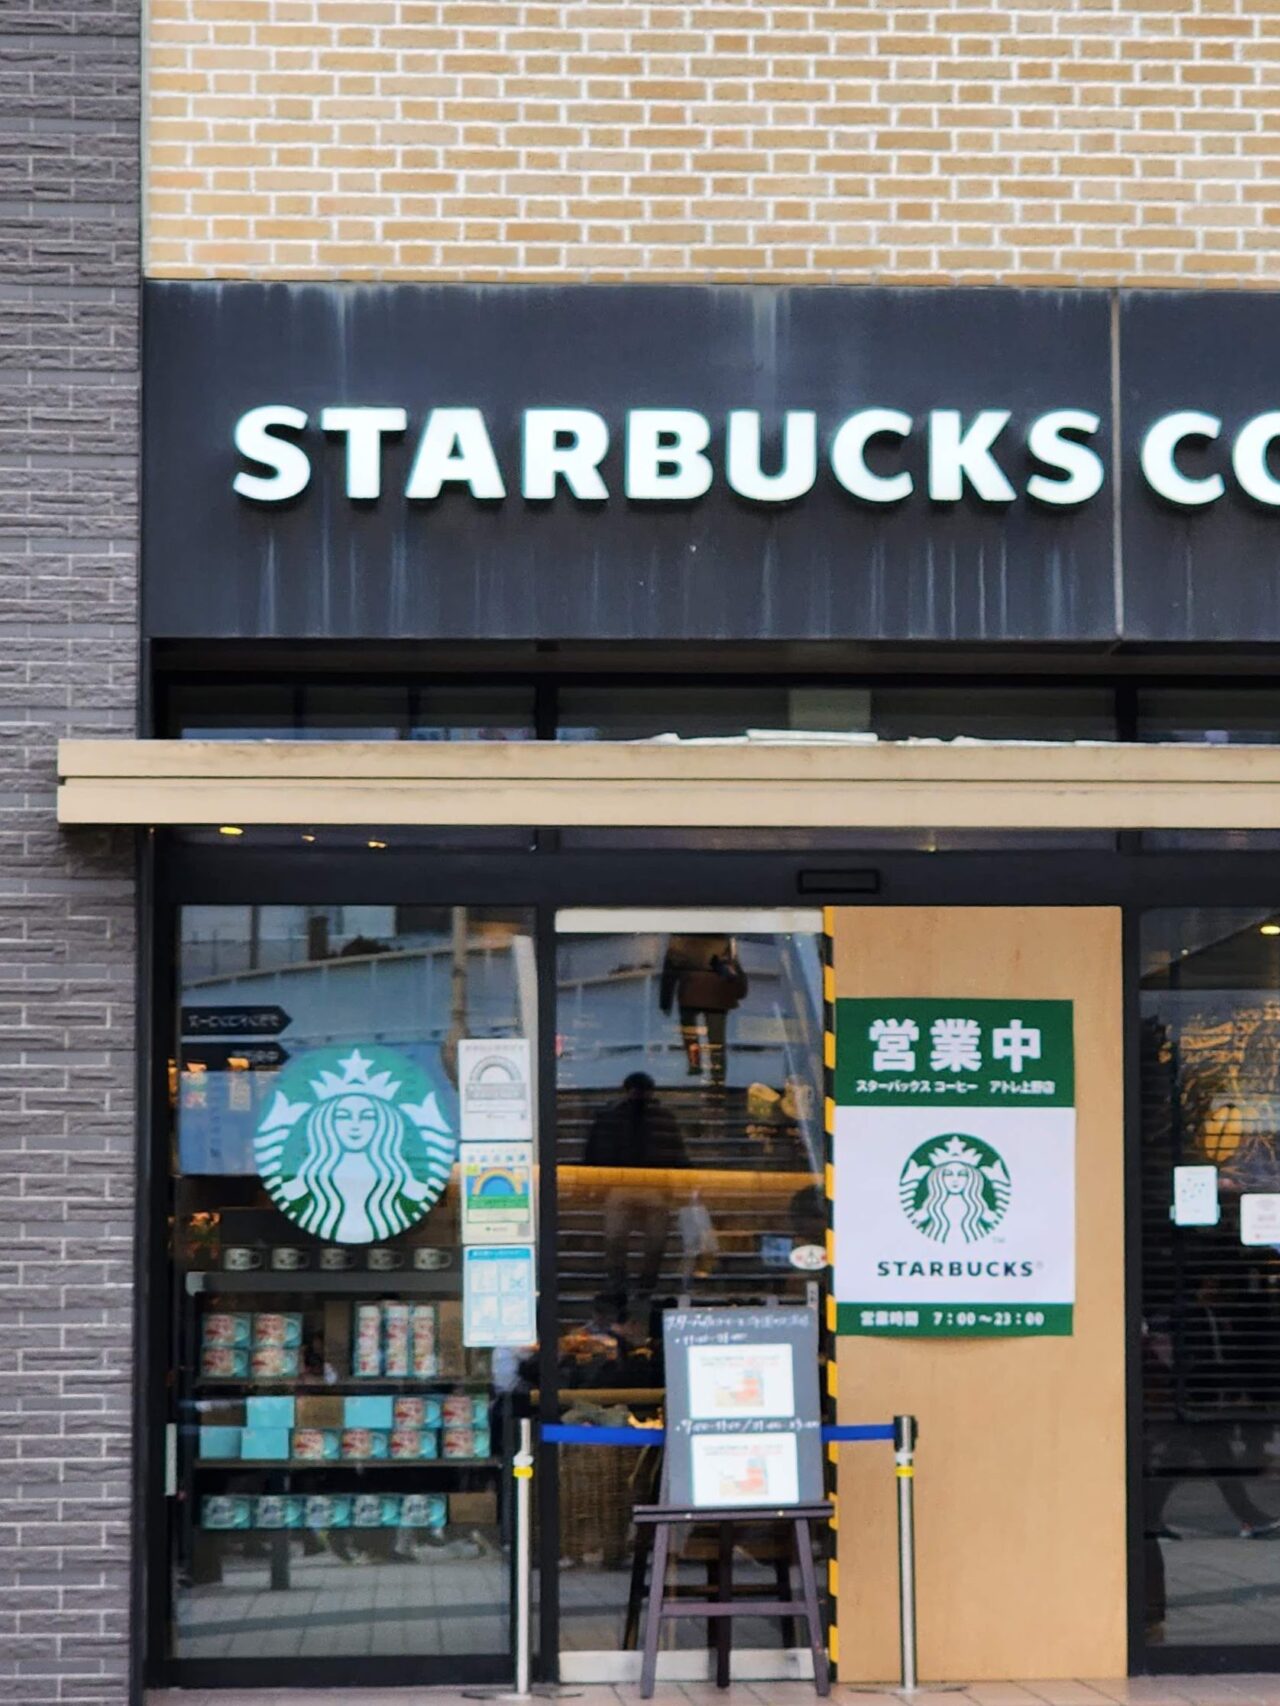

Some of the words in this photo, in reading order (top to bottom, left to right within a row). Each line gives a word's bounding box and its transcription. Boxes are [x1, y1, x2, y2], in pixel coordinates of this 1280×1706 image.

[232, 405, 1104, 505] STARBUCKS
[868, 1018, 1042, 1073] 営業中
[856, 1079, 932, 1093] スターバックス
[934, 1079, 979, 1093] コーヒー
[877, 1261, 1033, 1277] STARBUCKS
